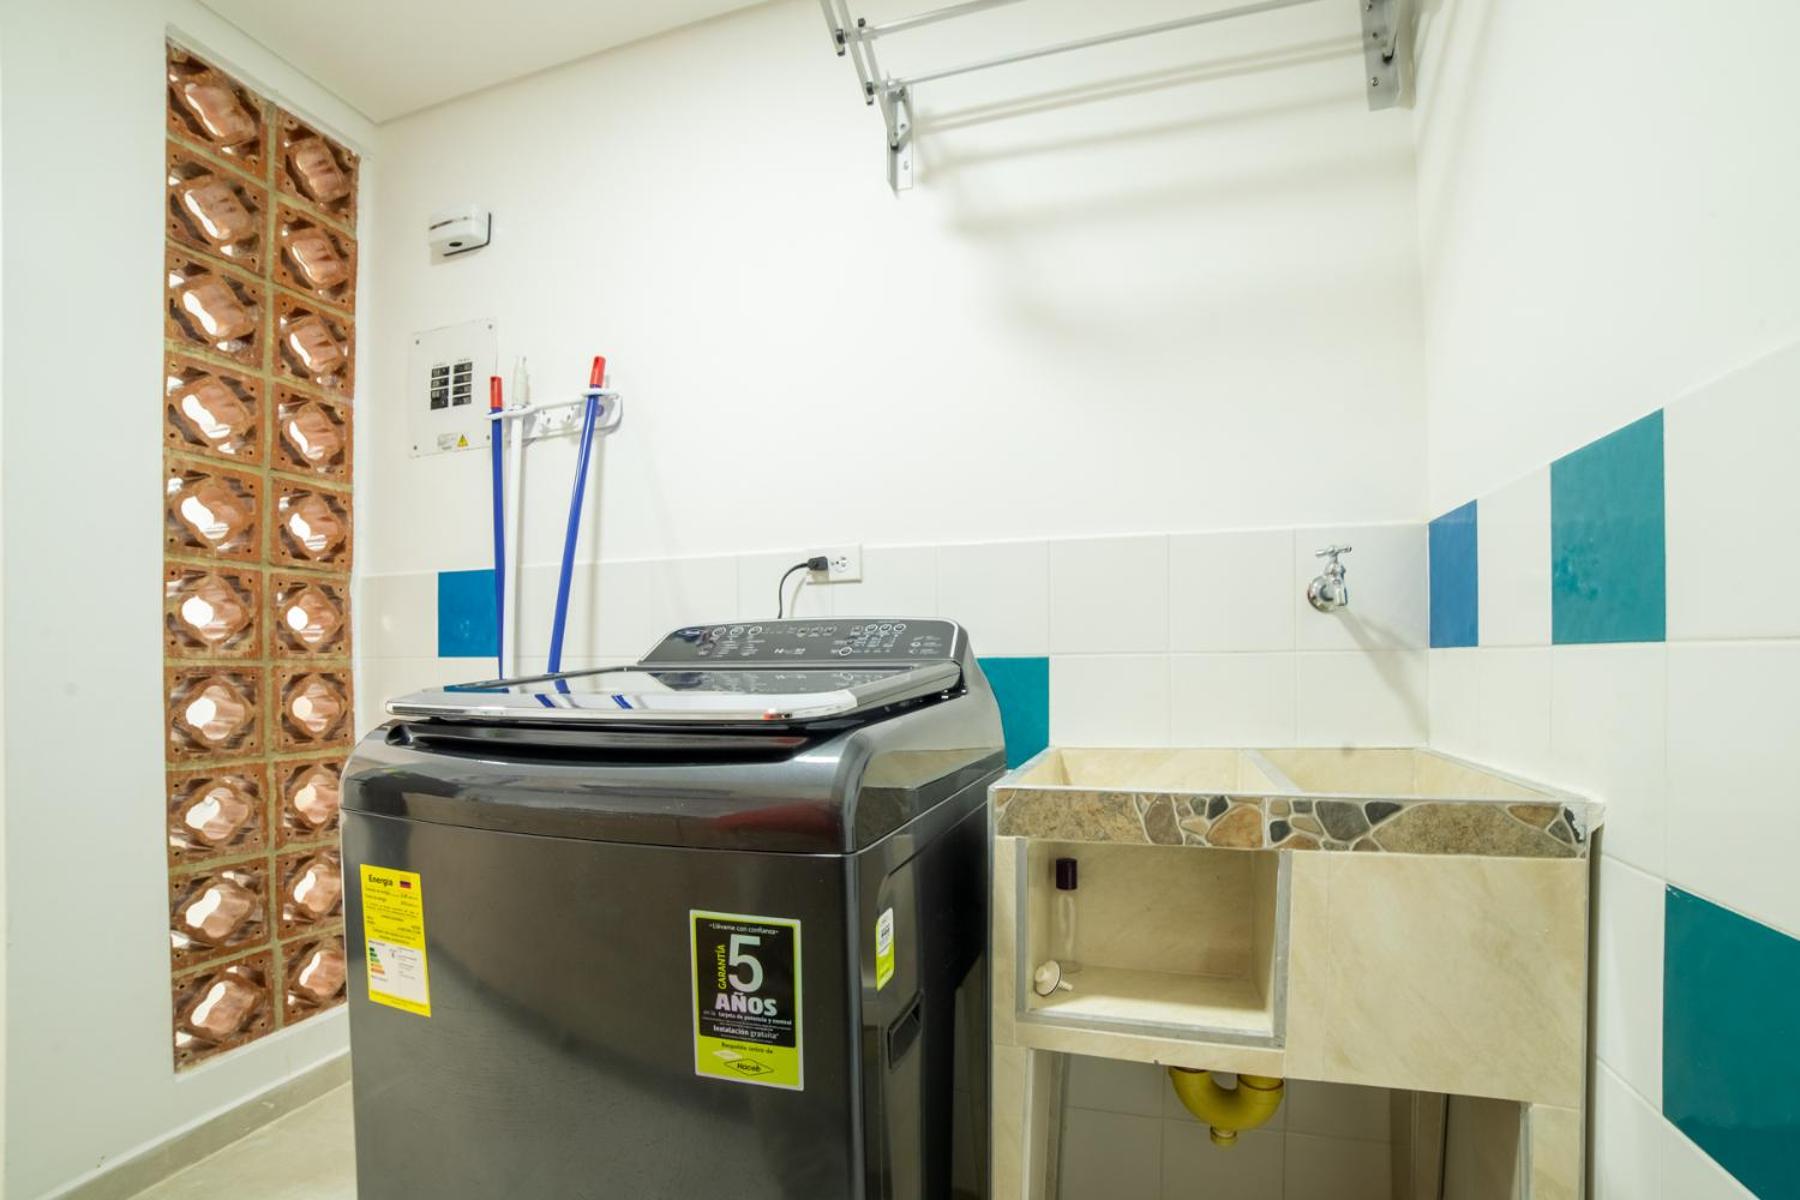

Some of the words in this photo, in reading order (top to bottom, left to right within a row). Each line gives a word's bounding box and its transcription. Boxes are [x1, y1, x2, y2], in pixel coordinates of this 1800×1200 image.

[715, 944, 726, 990] GARANTÍA
[728, 933, 763, 993] 5
[714, 991, 777, 1017] AÑOS
[713, 1025, 749, 1035] Instalación
